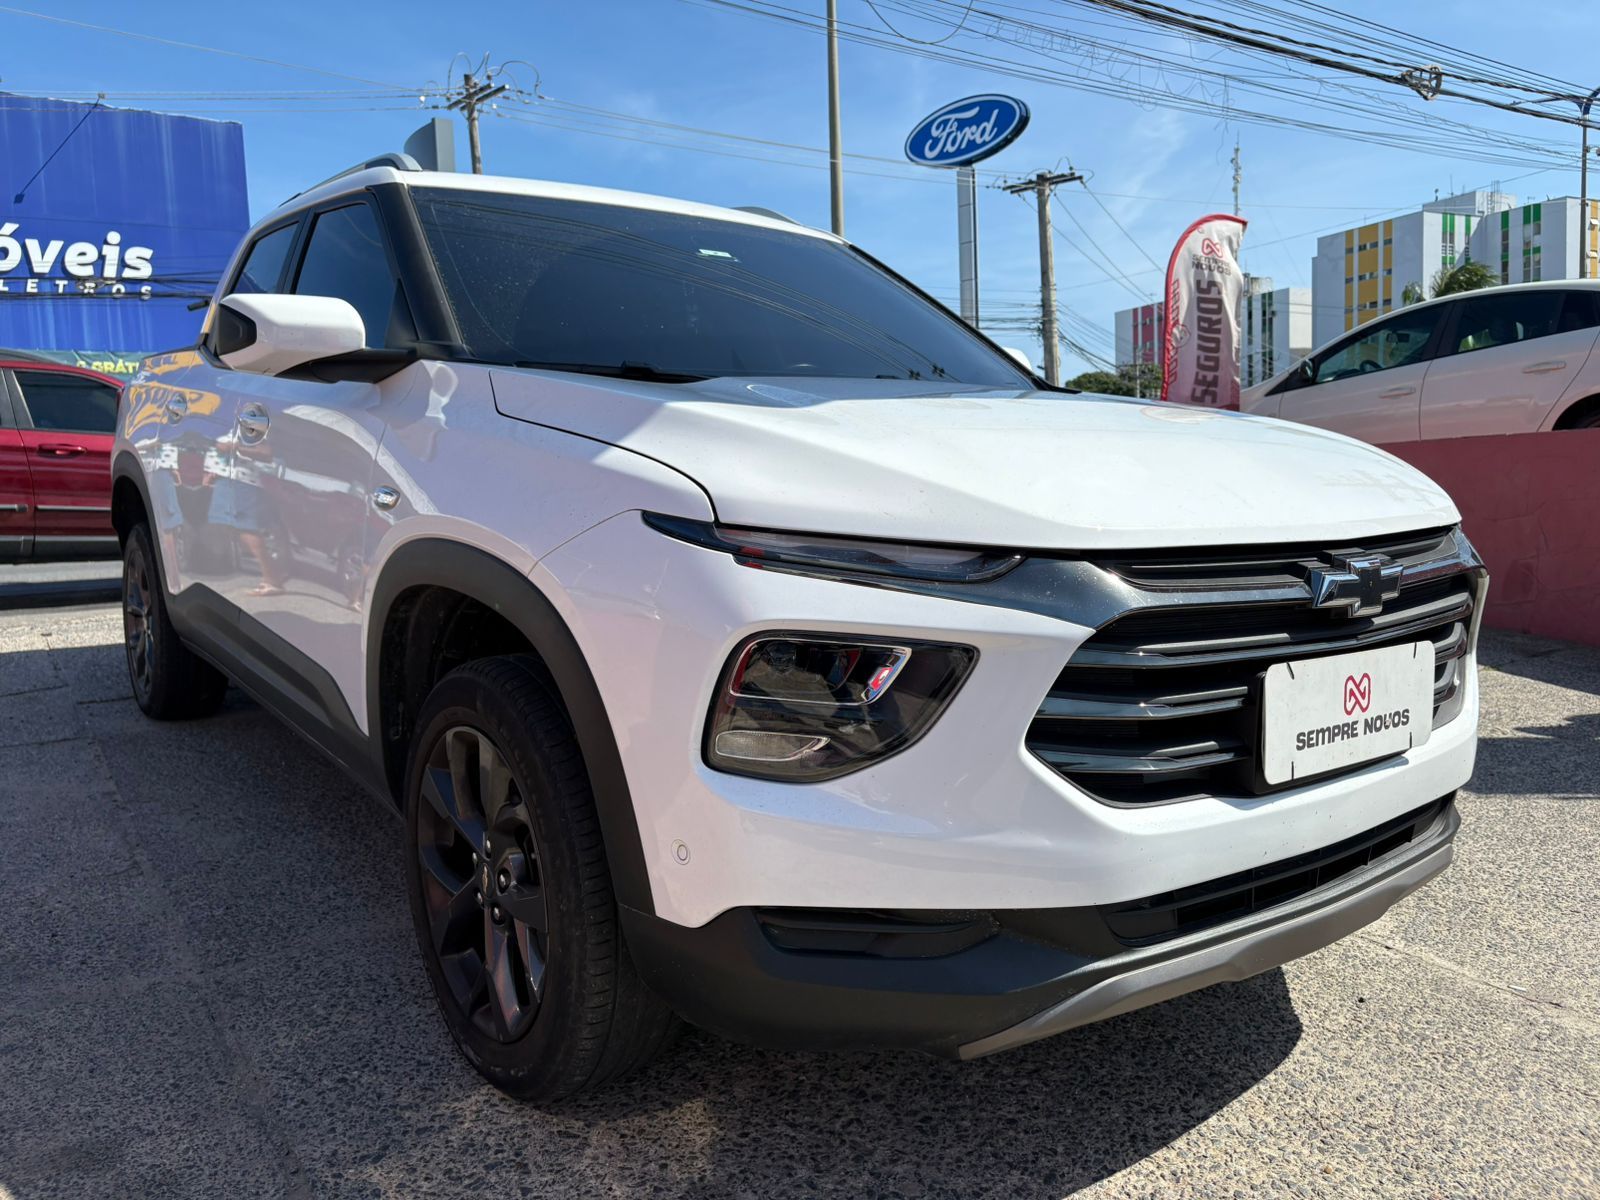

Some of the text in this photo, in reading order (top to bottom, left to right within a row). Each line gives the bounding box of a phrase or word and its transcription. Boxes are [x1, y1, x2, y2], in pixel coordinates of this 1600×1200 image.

[924, 106, 999, 159] Ford
[0, 222, 153, 279] óveis
[1191, 279, 1223, 404] SEGUROS
[1296, 708, 1410, 751] SEMPRE NOVOS
